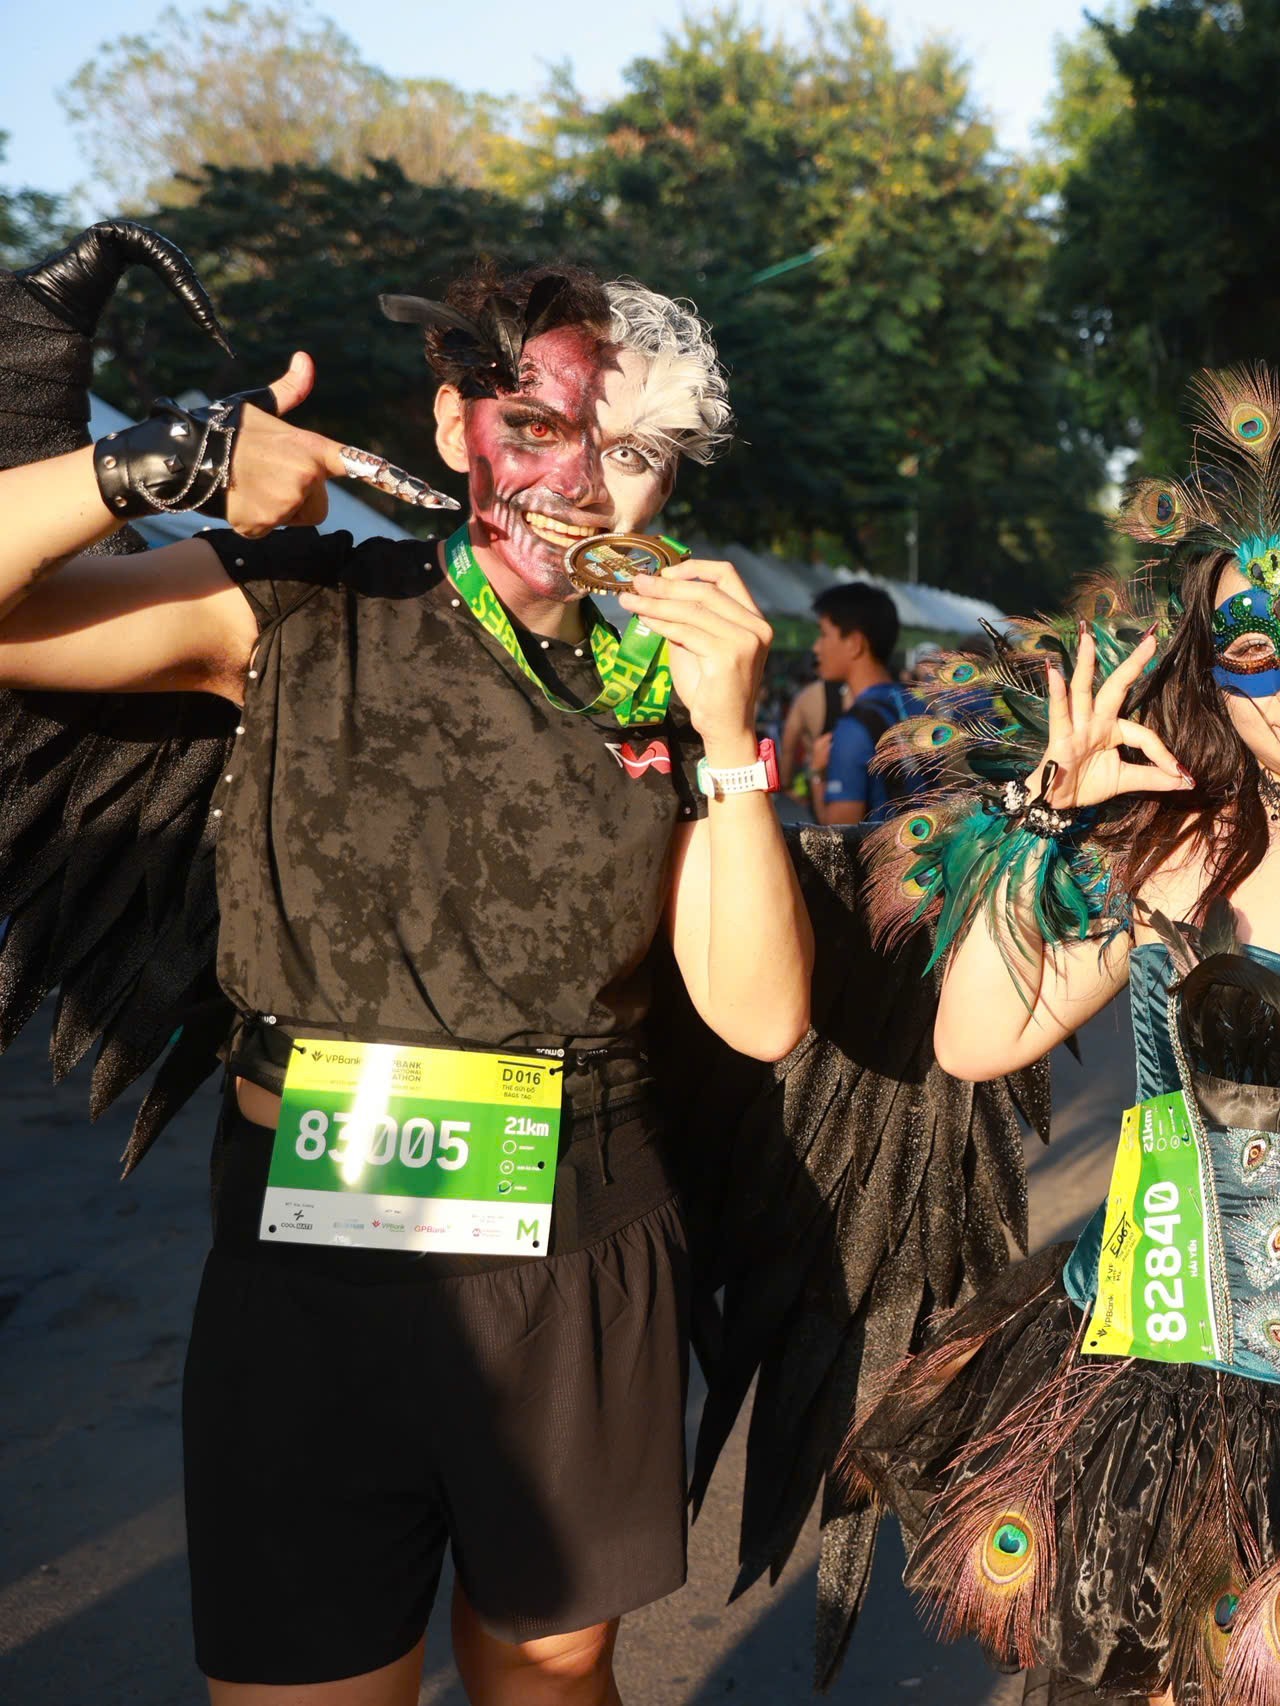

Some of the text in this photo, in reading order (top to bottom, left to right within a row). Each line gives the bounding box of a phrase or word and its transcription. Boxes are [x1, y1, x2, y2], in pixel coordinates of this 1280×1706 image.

[295, 1110, 471, 1171] 83005
[504, 1116, 550, 1137] 21km
[1142, 1110, 1153, 1154] 21km
[517, 1218, 539, 1241] M
[1143, 1180, 1188, 1343] 82840
[1104, 1296, 1114, 1328] VPBank
